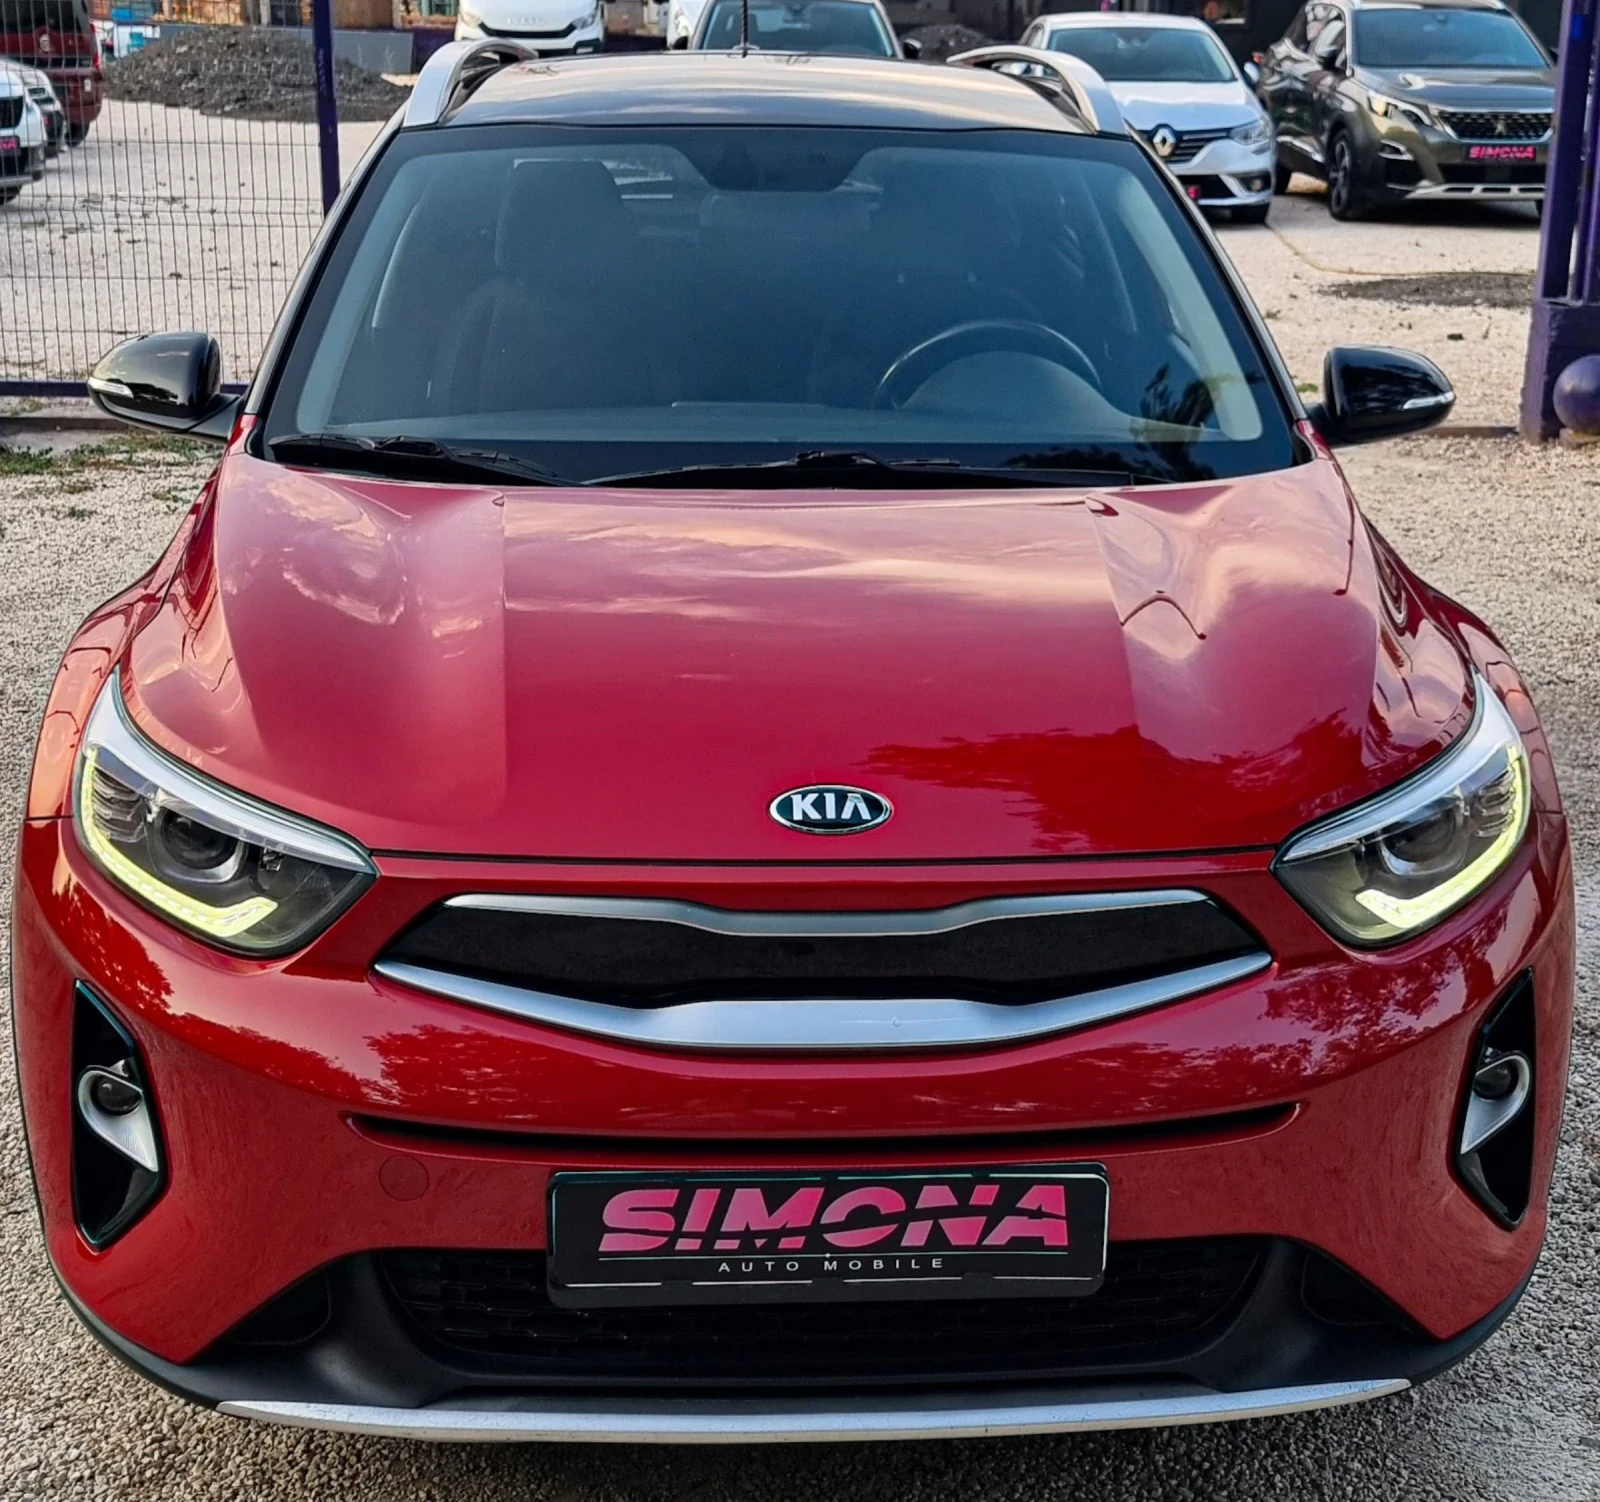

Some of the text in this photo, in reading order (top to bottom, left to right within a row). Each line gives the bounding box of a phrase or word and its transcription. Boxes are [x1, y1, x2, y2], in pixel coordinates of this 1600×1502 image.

[1469, 145, 1534, 159] SIMONA
[790, 792, 872, 820] KIA
[598, 1185, 1068, 1252] SIMONA
[718, 1258, 942, 1273] AUTO MOBILE
